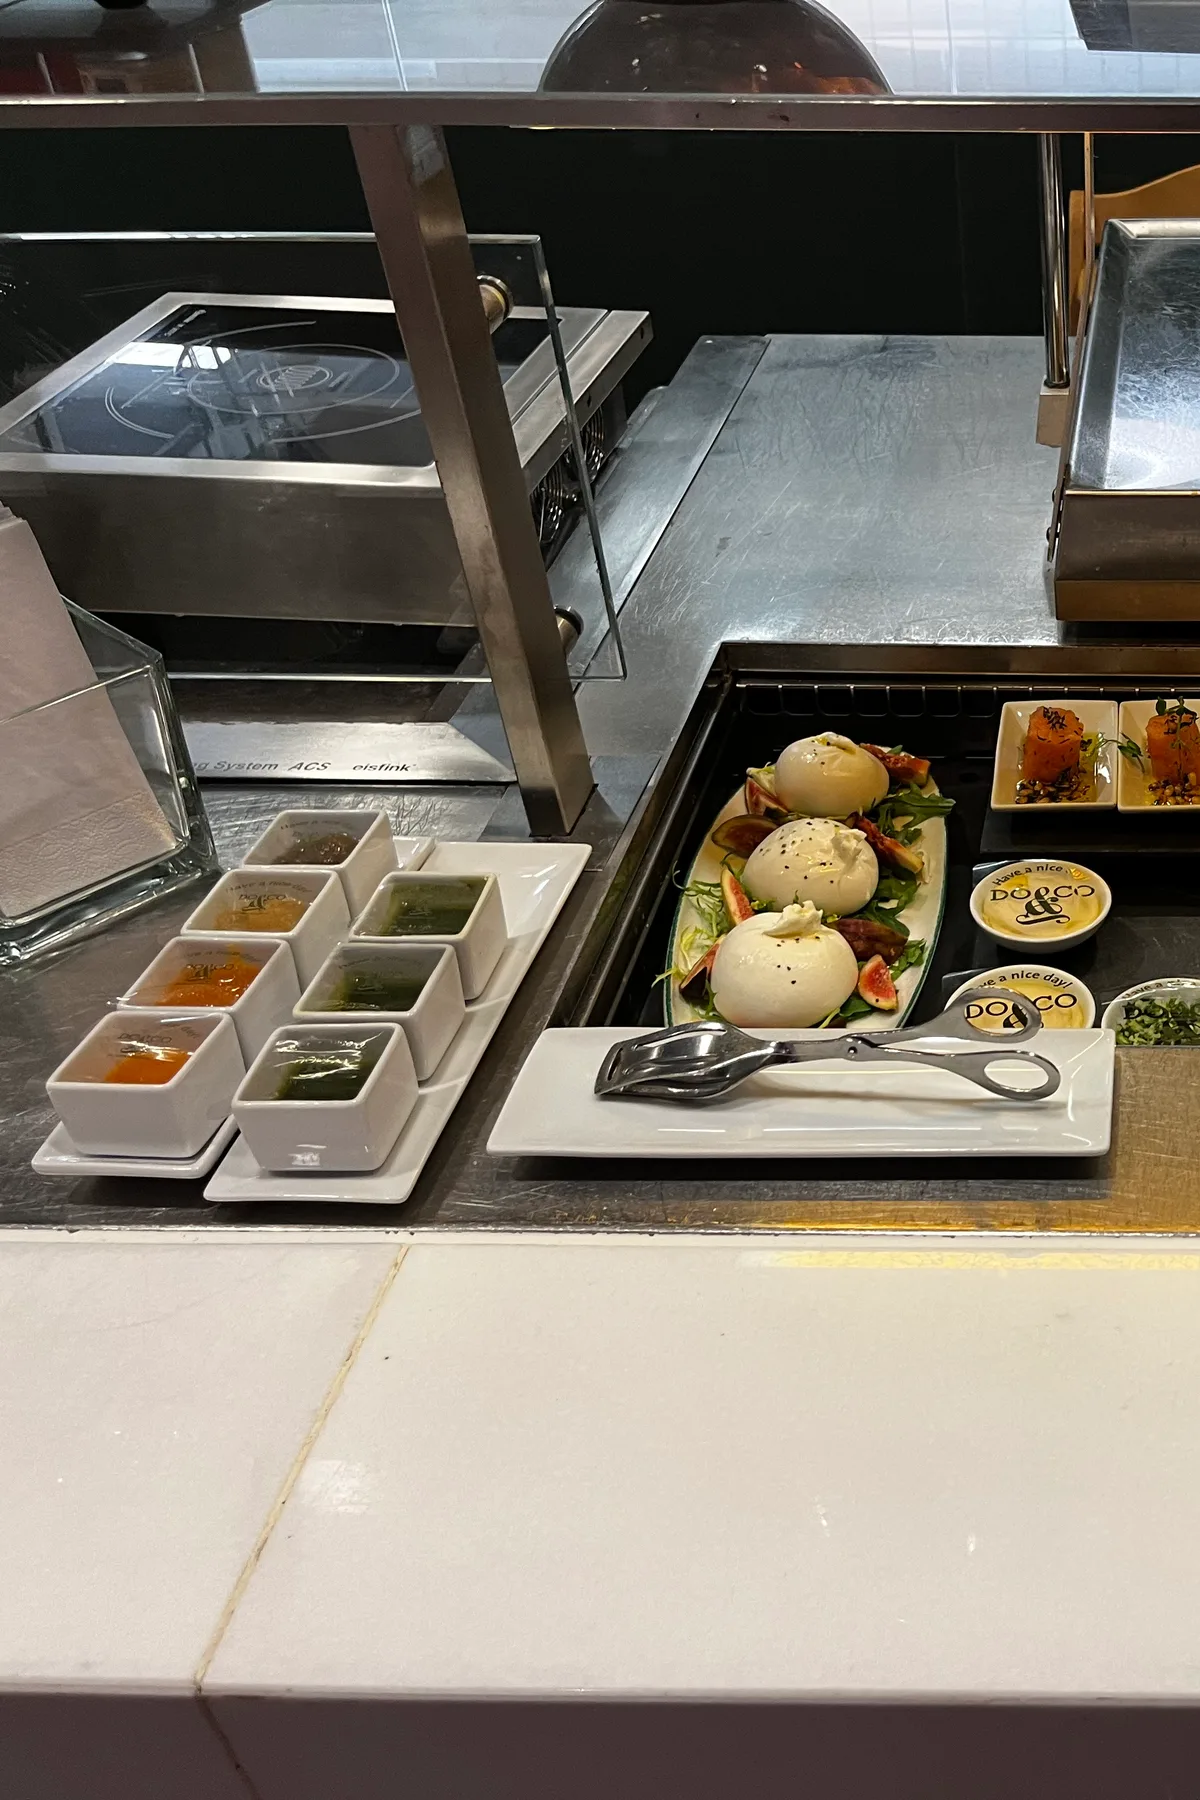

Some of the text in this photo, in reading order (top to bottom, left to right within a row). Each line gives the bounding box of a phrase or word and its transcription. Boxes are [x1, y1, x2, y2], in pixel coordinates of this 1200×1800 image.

[214, 760, 279, 772] System
[992, 869, 1023, 886] Have
[1036, 864, 1063, 872] nice
[990, 885, 1095, 918] DO&CO
[999, 975, 1007, 983] a
[1011, 970, 1041, 980] nice
[1043, 973, 1074, 989] day!
